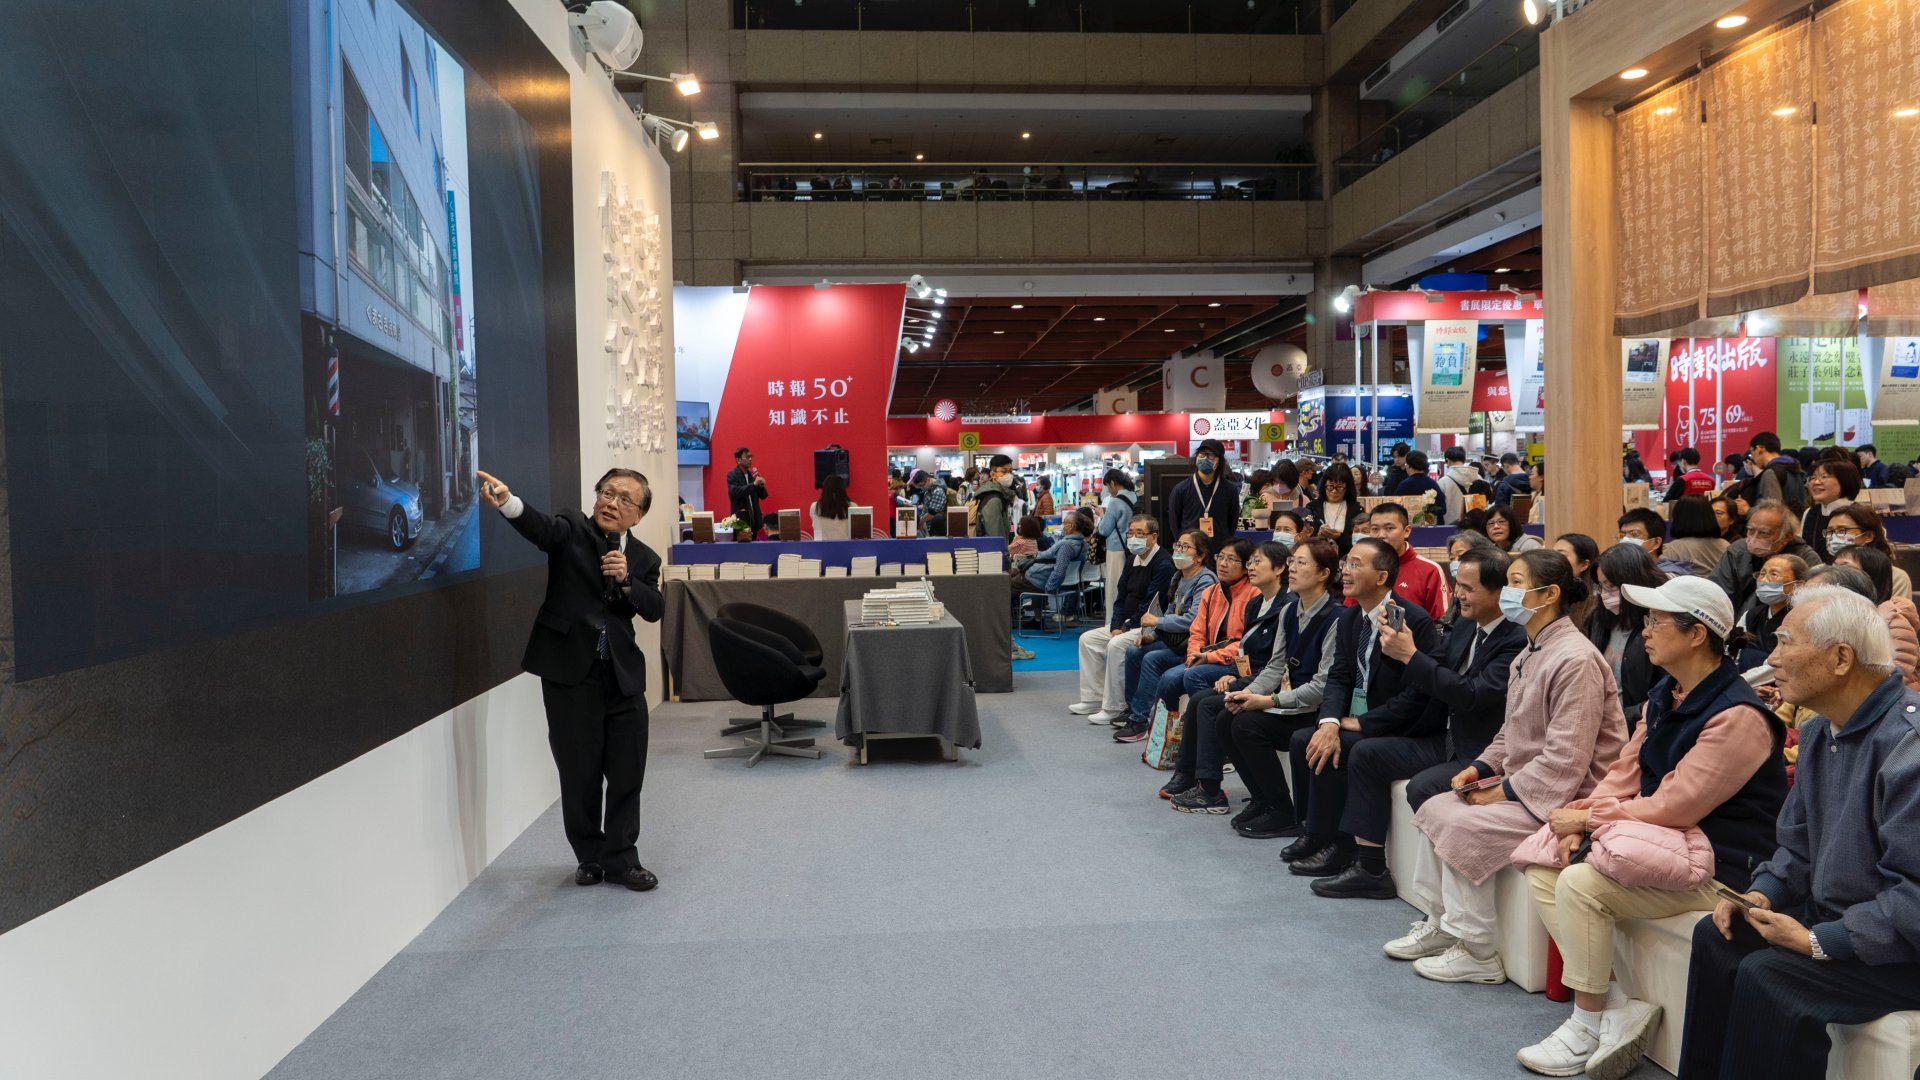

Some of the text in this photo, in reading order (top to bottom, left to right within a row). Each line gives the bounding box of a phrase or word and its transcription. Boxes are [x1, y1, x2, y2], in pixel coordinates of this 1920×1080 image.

[1460, 299, 1523, 311] 書展限定優惠
[1434, 355, 1457, 368] 抱負
[1670, 338, 1768, 383] 時報出版
[1190, 366, 1209, 388] C
[767, 379, 806, 397] 時報
[1112, 398, 1126, 414] C
[768, 407, 850, 426] 知識不止
[1213, 417, 1266, 431] 蓋亞文化
